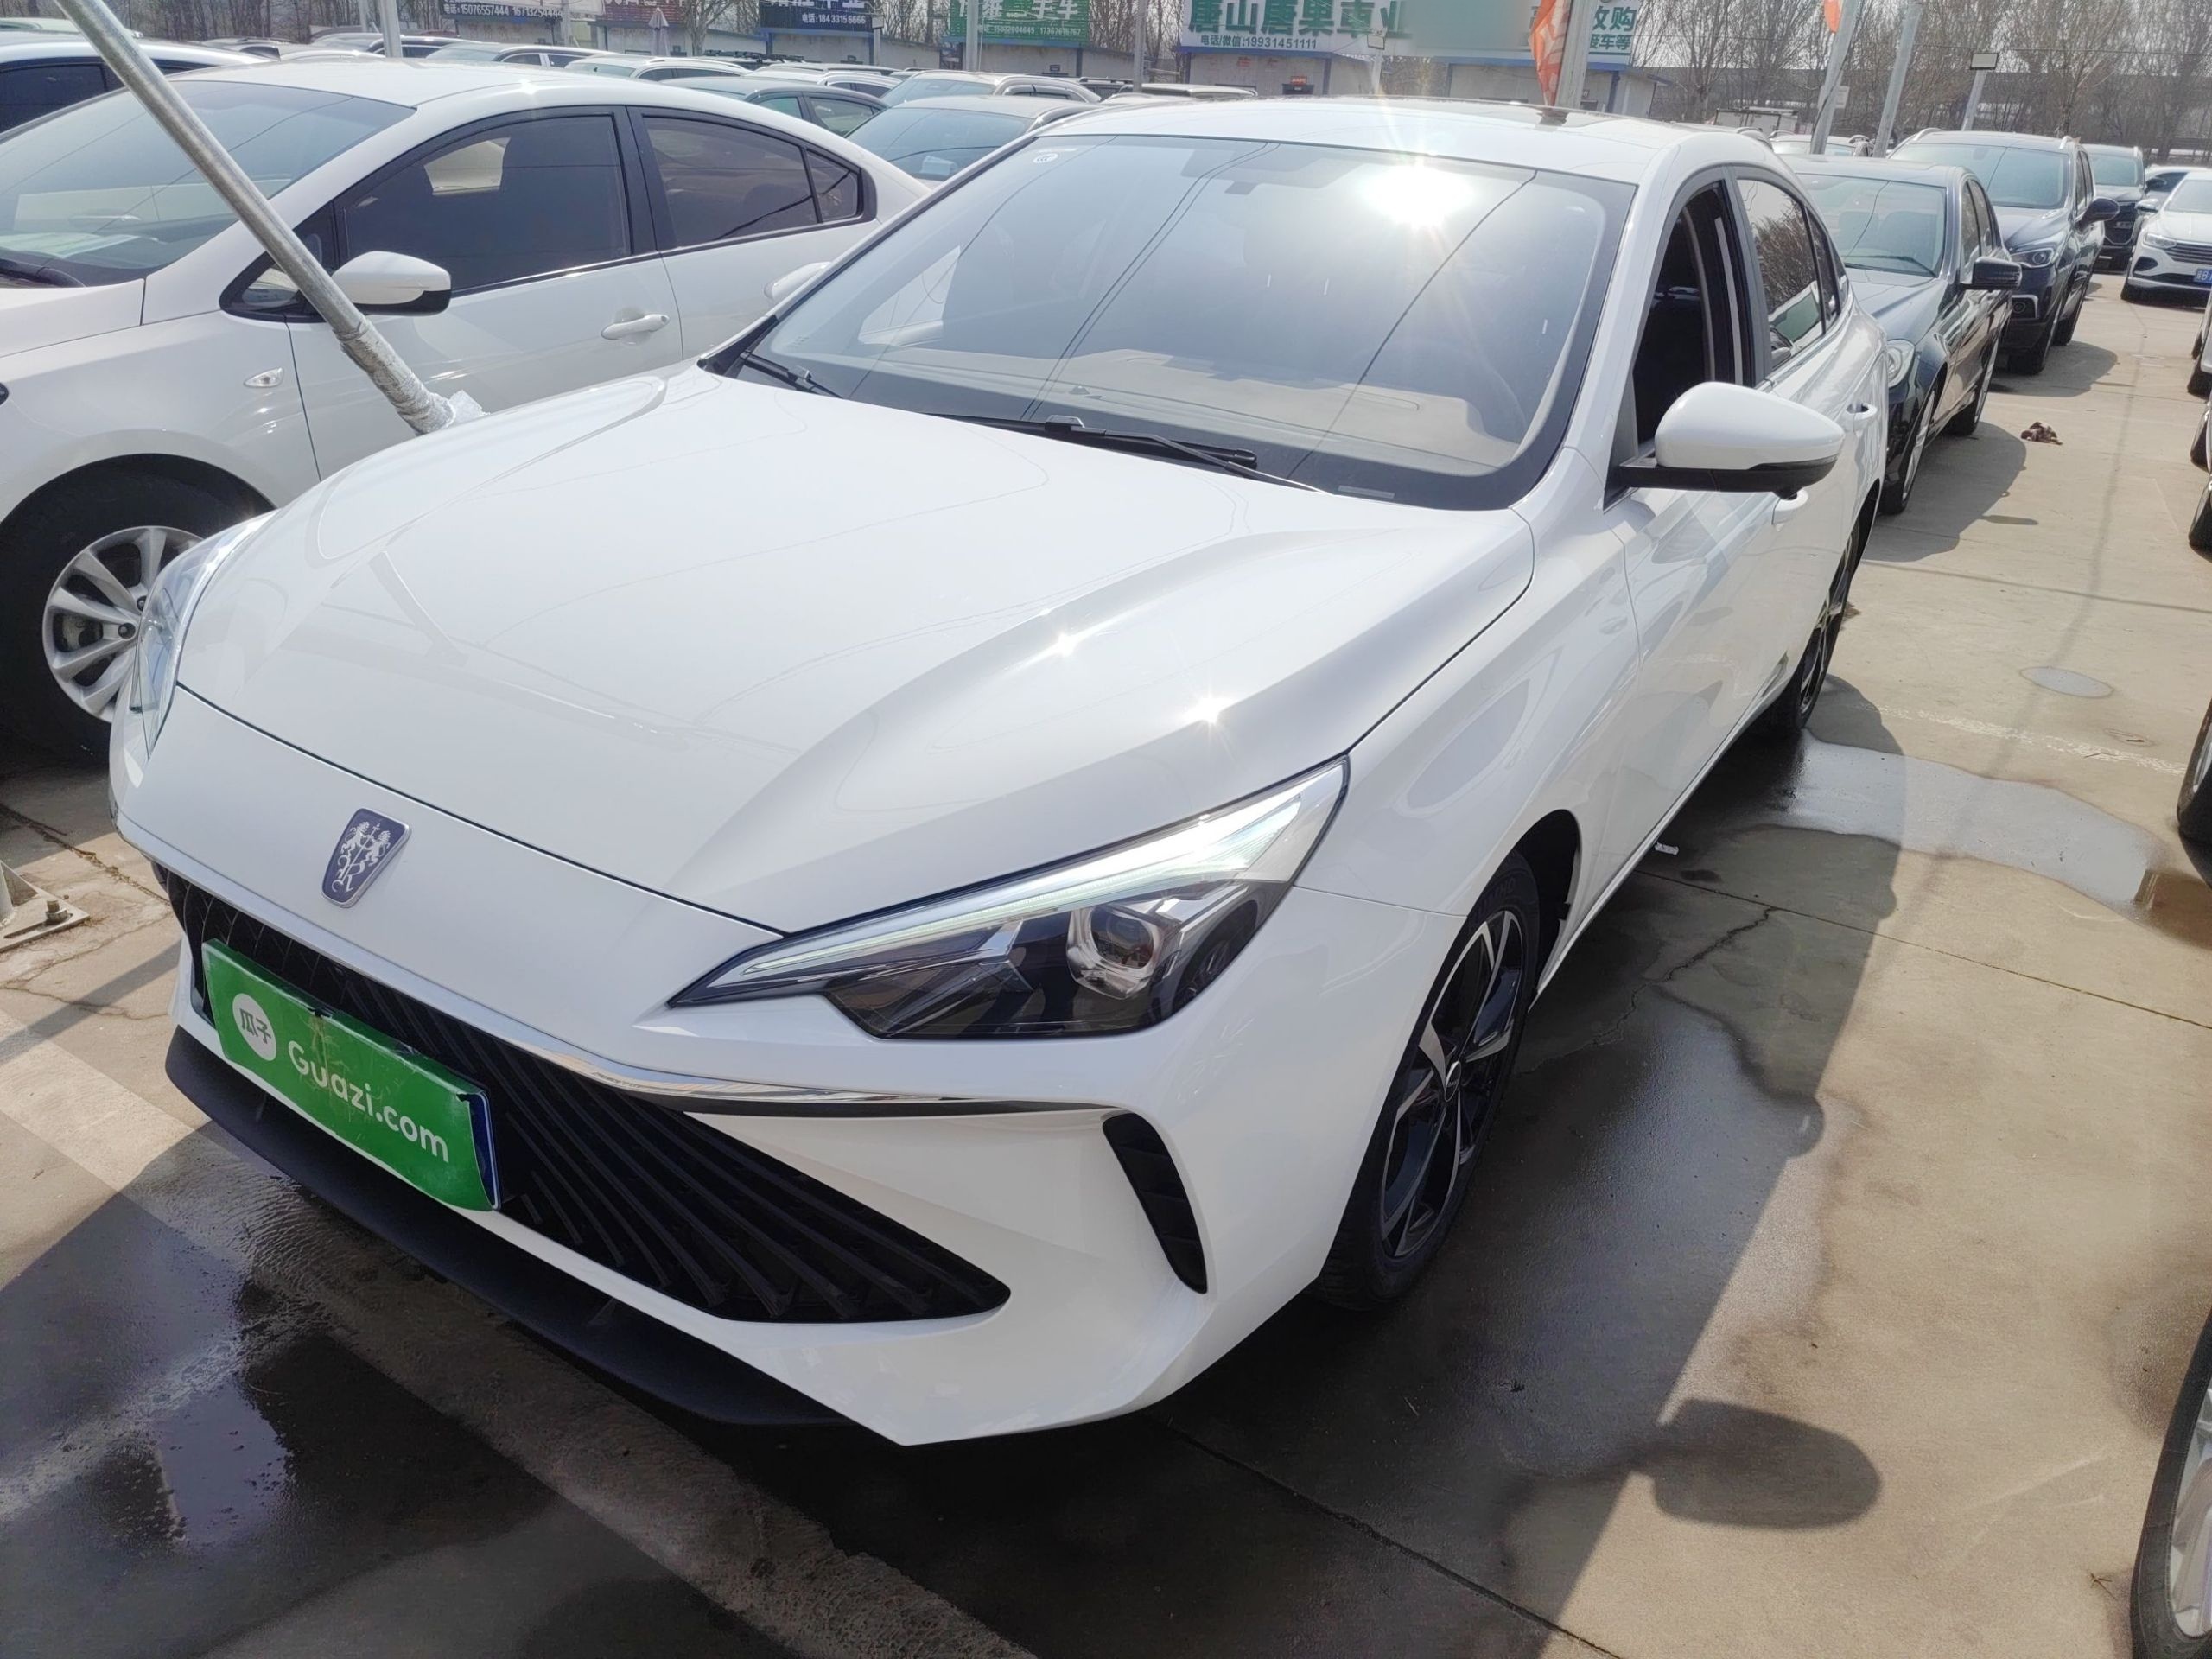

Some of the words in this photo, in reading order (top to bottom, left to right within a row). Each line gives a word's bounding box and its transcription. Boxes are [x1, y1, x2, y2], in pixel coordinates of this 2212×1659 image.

[1200, 35, 1317, 49] 电话/微信:19931451111
[239, 1007, 272, 1046] 瓜子
[288, 1039, 450, 1164] Guazi.com
